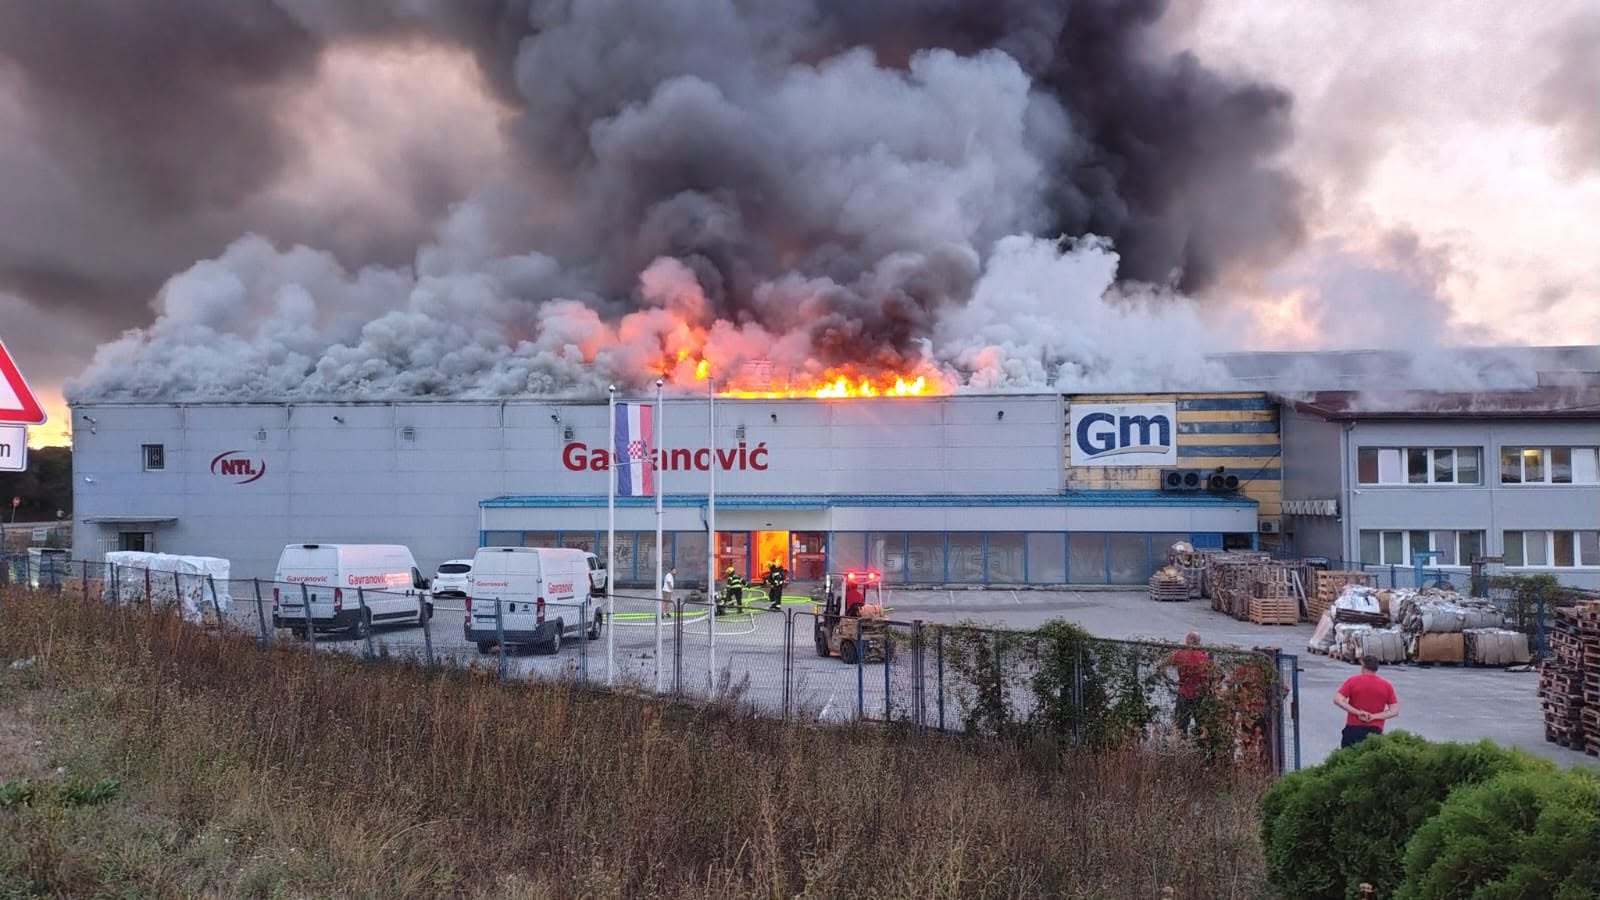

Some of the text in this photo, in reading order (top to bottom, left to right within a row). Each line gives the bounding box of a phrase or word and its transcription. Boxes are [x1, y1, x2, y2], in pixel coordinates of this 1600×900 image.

[1076, 412, 1170, 456] Gm
[221, 458, 256, 475] NTL
[562, 442, 769, 472] Gaanović
